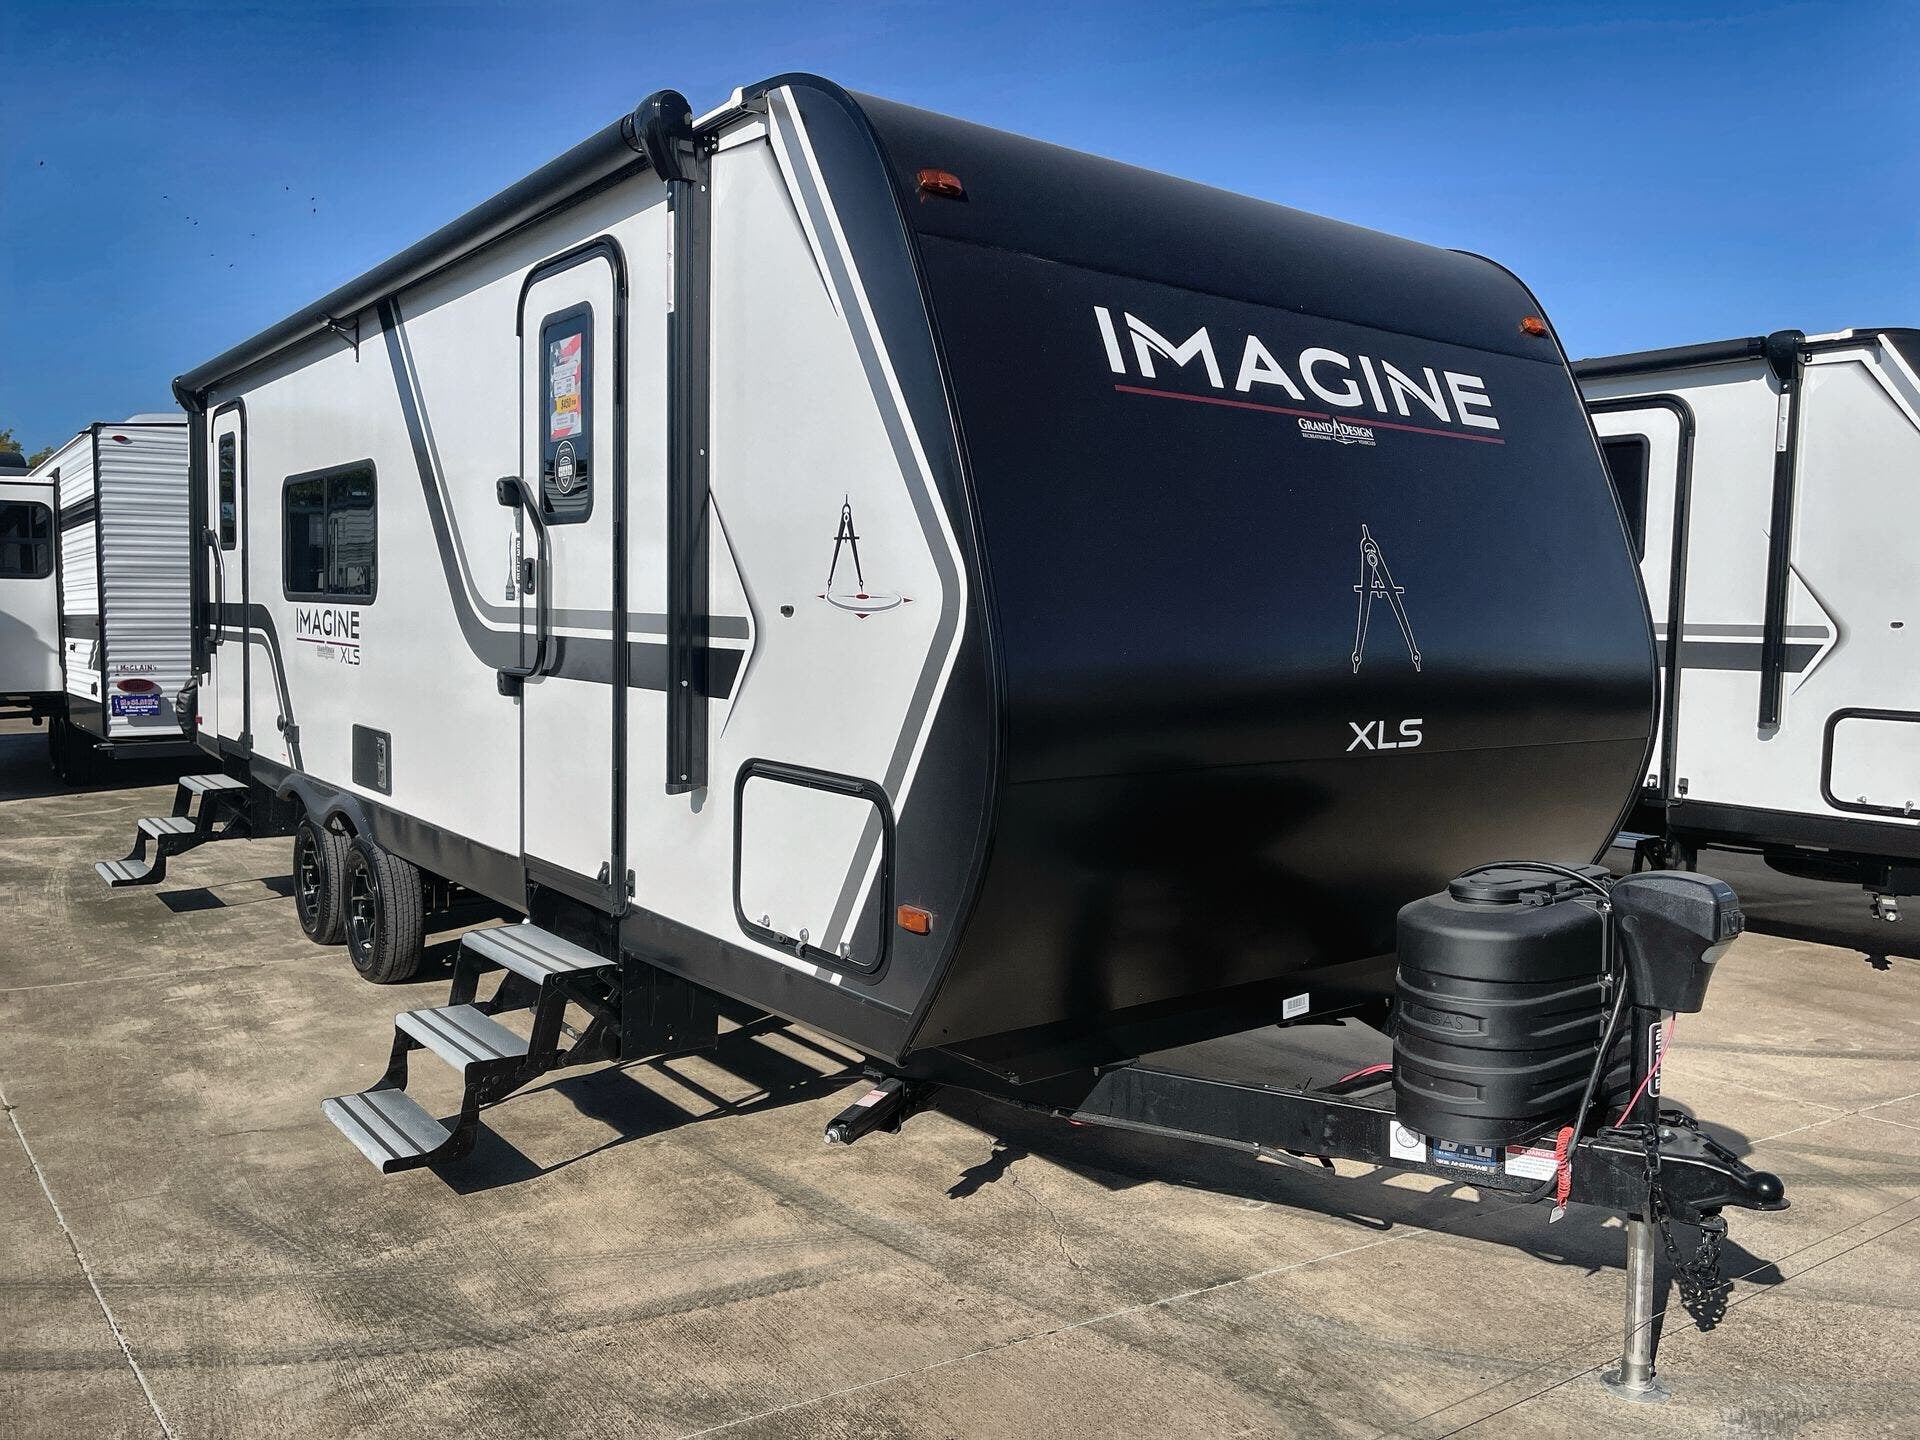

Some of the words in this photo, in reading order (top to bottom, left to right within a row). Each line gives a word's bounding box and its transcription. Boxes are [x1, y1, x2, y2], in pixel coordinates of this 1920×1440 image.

[1093, 305, 1500, 430] IMAGINE
[1298, 417, 1333, 433] GRAND
[1340, 423, 1374, 438] DESIGN
[296, 607, 360, 639] IMAGINE
[340, 647, 360, 665] XLS
[1345, 718, 1423, 752] XLS
[1429, 1011, 1464, 1030] GAS
